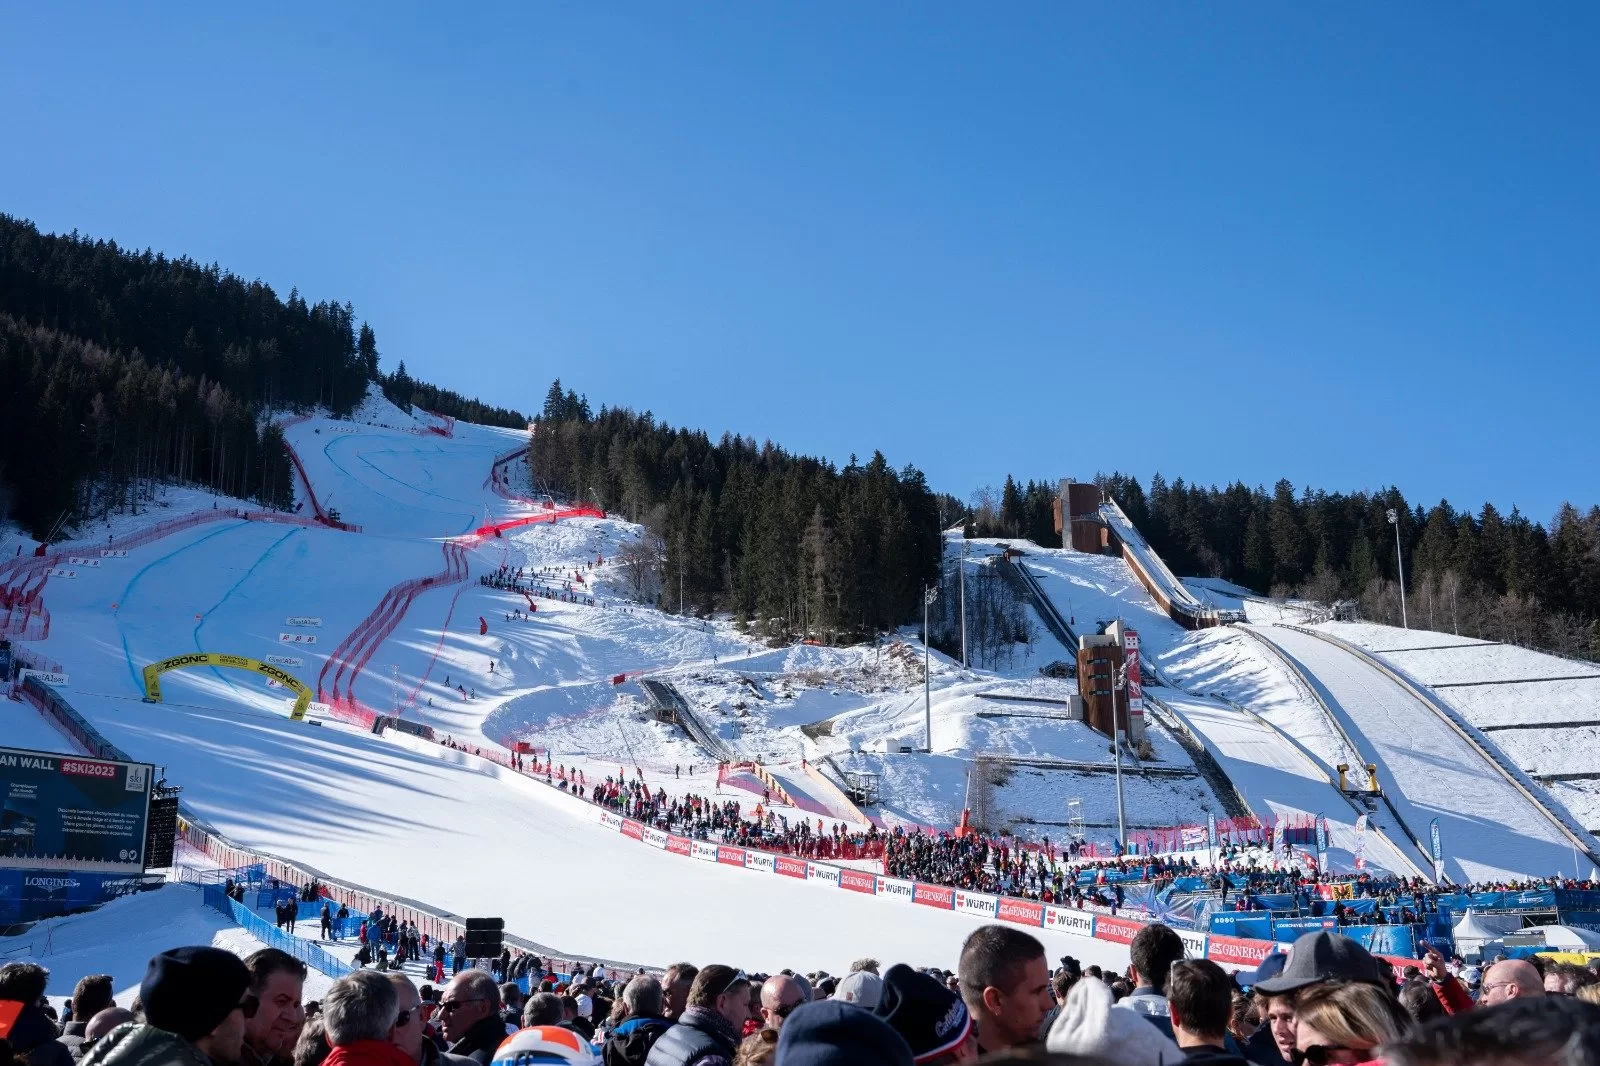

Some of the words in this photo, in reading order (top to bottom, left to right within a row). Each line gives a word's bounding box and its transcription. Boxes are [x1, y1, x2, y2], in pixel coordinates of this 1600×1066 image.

[164, 655, 208, 669] ZGONC
[259, 663, 299, 687] ZGONC
[0, 755, 17, 766] AN
[21, 757, 54, 770] WALL
[62, 761, 115, 777] #SKI2023
[25, 877, 76, 887] LONGINES
[815, 869, 838, 881] WÜRTH
[885, 884, 911, 896] WÜRTH
[966, 898, 995, 911] WÜRTH
[1008, 906, 1041, 920] GENERALI
[1057, 914, 1091, 930] WÜRTH
[1107, 924, 1138, 939] GENERA
[1181, 938, 1203, 951] RTH
